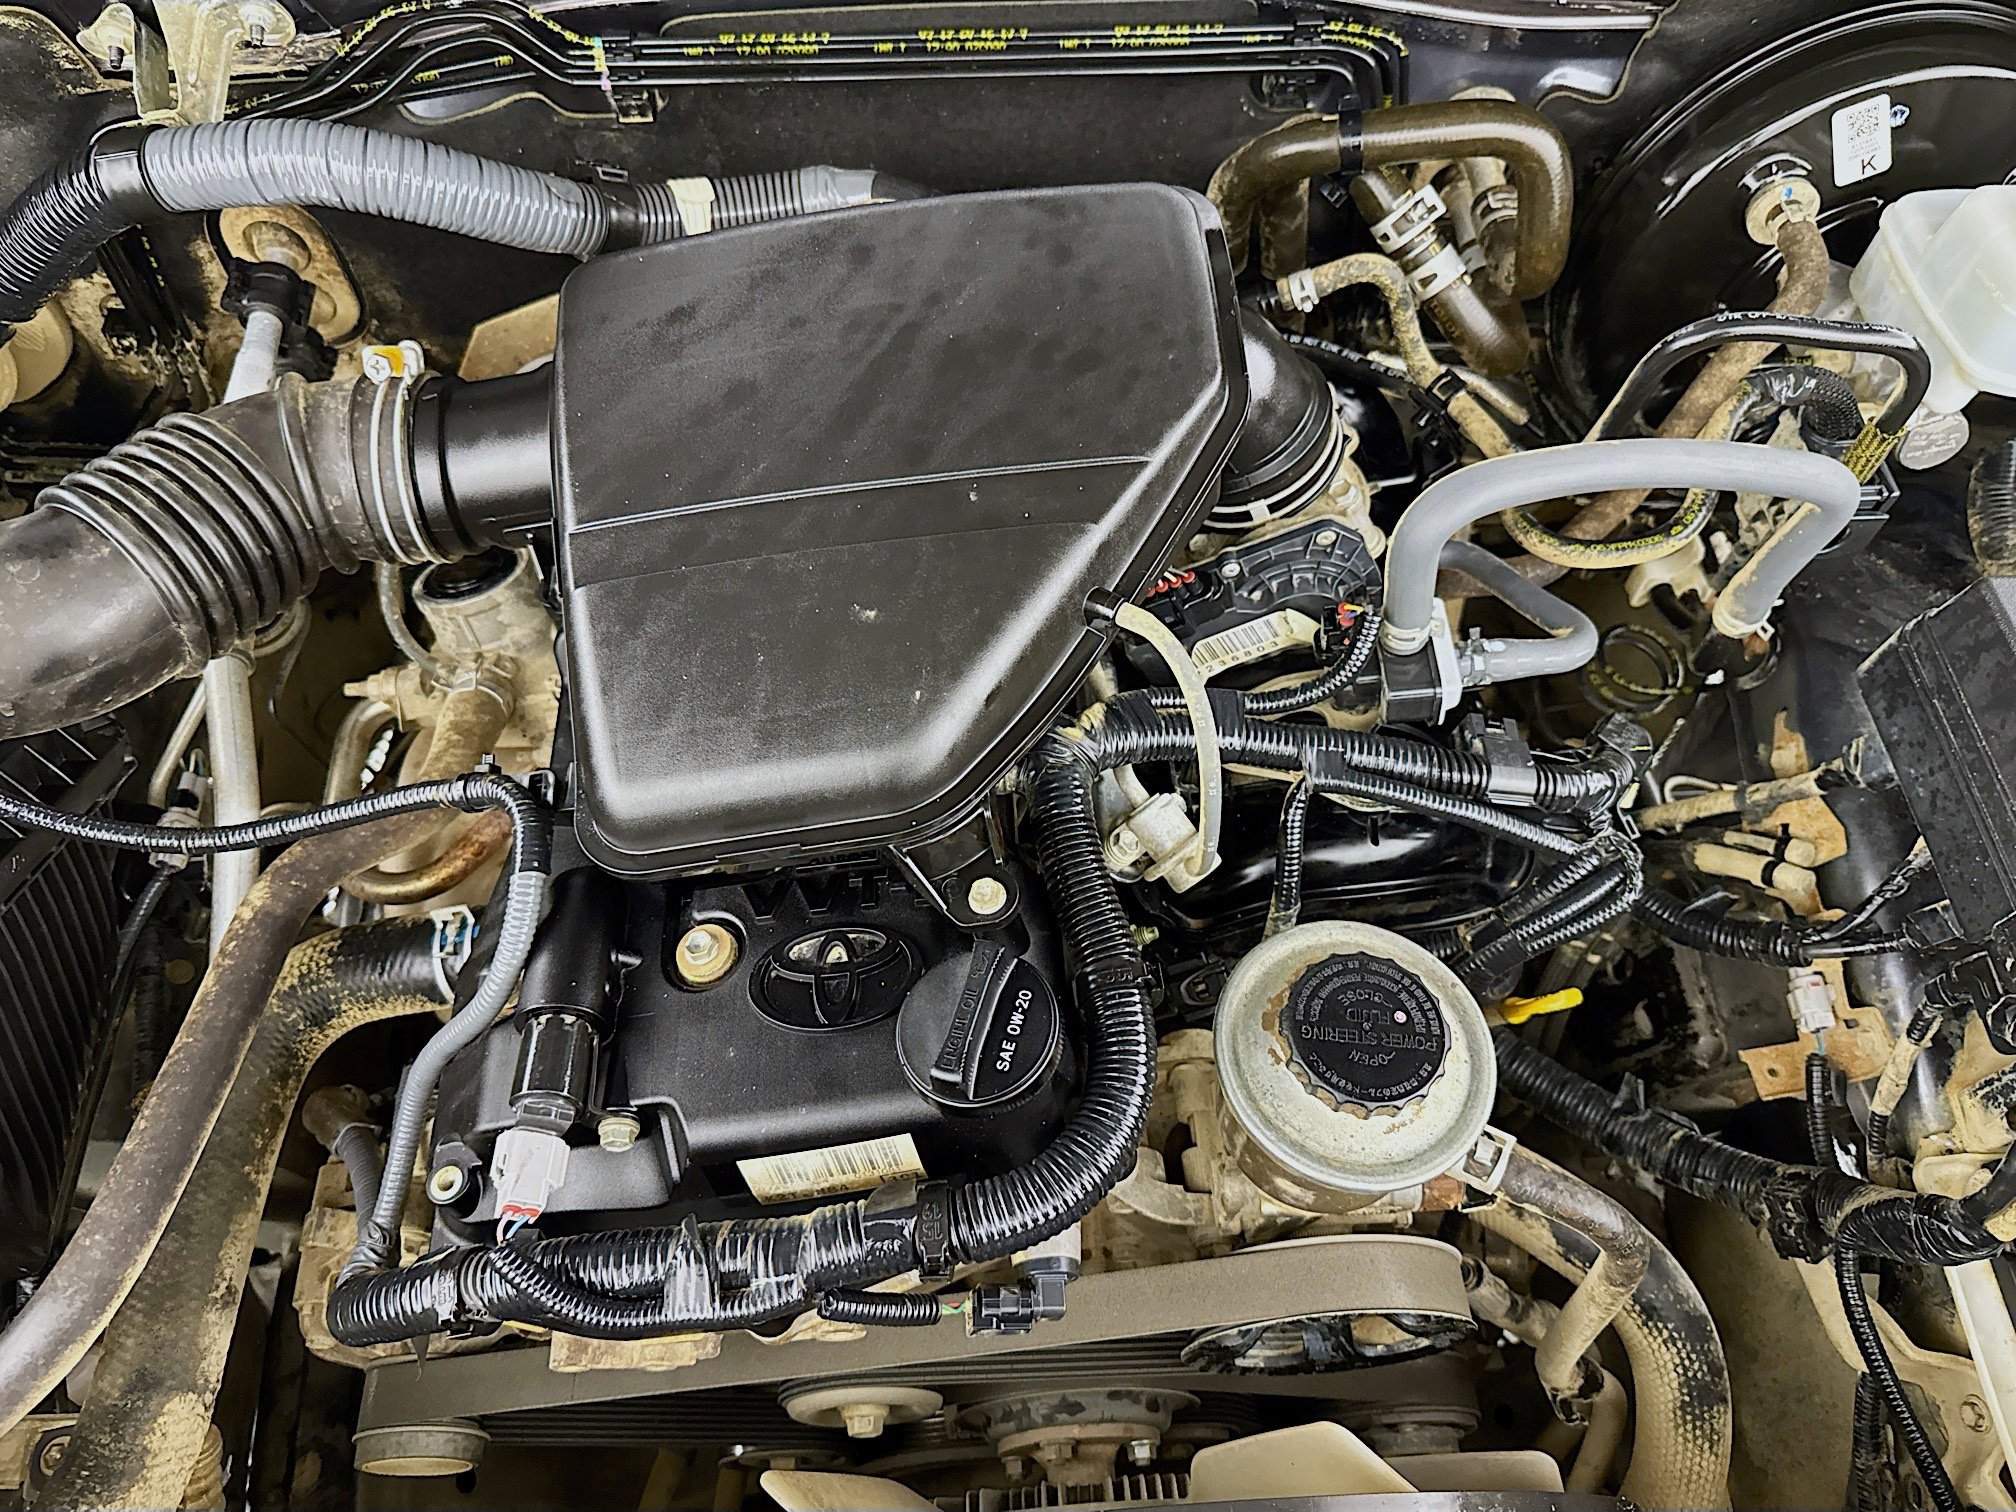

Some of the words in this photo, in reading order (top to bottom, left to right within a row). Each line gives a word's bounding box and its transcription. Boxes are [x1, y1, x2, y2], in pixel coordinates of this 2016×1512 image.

[1861, 154, 1877, 175] K
[1337, 989, 1384, 1006] CLOSE
[1346, 1007, 1390, 1025] FLUID
[941, 1014, 971, 1070] ENGINE
[961, 989, 979, 1010] OIL
[996, 1040, 1016, 1072] SAE
[1007, 990, 1033, 1036] 0W-20
[1301, 1025, 1378, 1045] STEERING
[1381, 1032, 1438, 1051] POWER
[1349, 1049, 1388, 1067] OPEN
